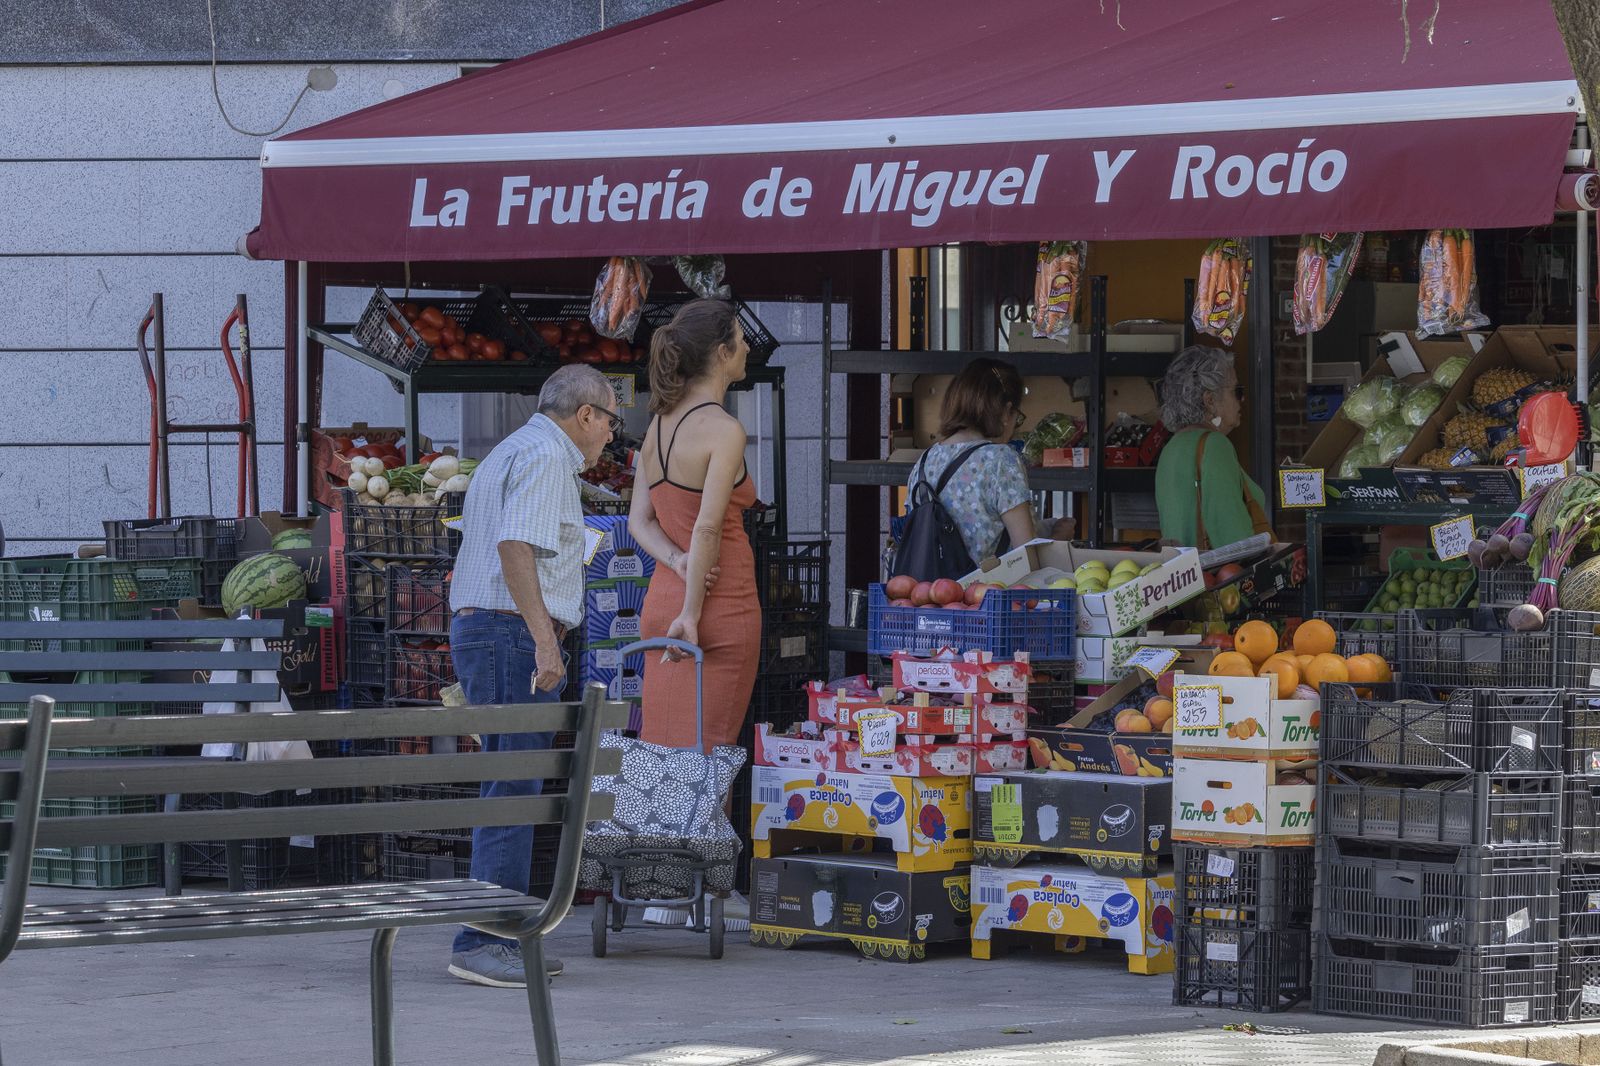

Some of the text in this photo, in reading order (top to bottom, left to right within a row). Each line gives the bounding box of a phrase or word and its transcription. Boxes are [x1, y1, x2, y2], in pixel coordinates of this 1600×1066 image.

[409, 138, 1348, 228] La Frutería de Miguel Y Rocío
[1142, 567, 1198, 607] Perlim
[282, 643, 318, 672] Gold
[1080, 761, 1111, 772] Andrés
[827, 778, 849, 789] Natur
[810, 789, 852, 807] Coplaca
[920, 789, 945, 800] Natur
[1179, 801, 1218, 822] Torres
[1052, 879, 1077, 890] Natur
[1033, 890, 1080, 908] Coplaca
